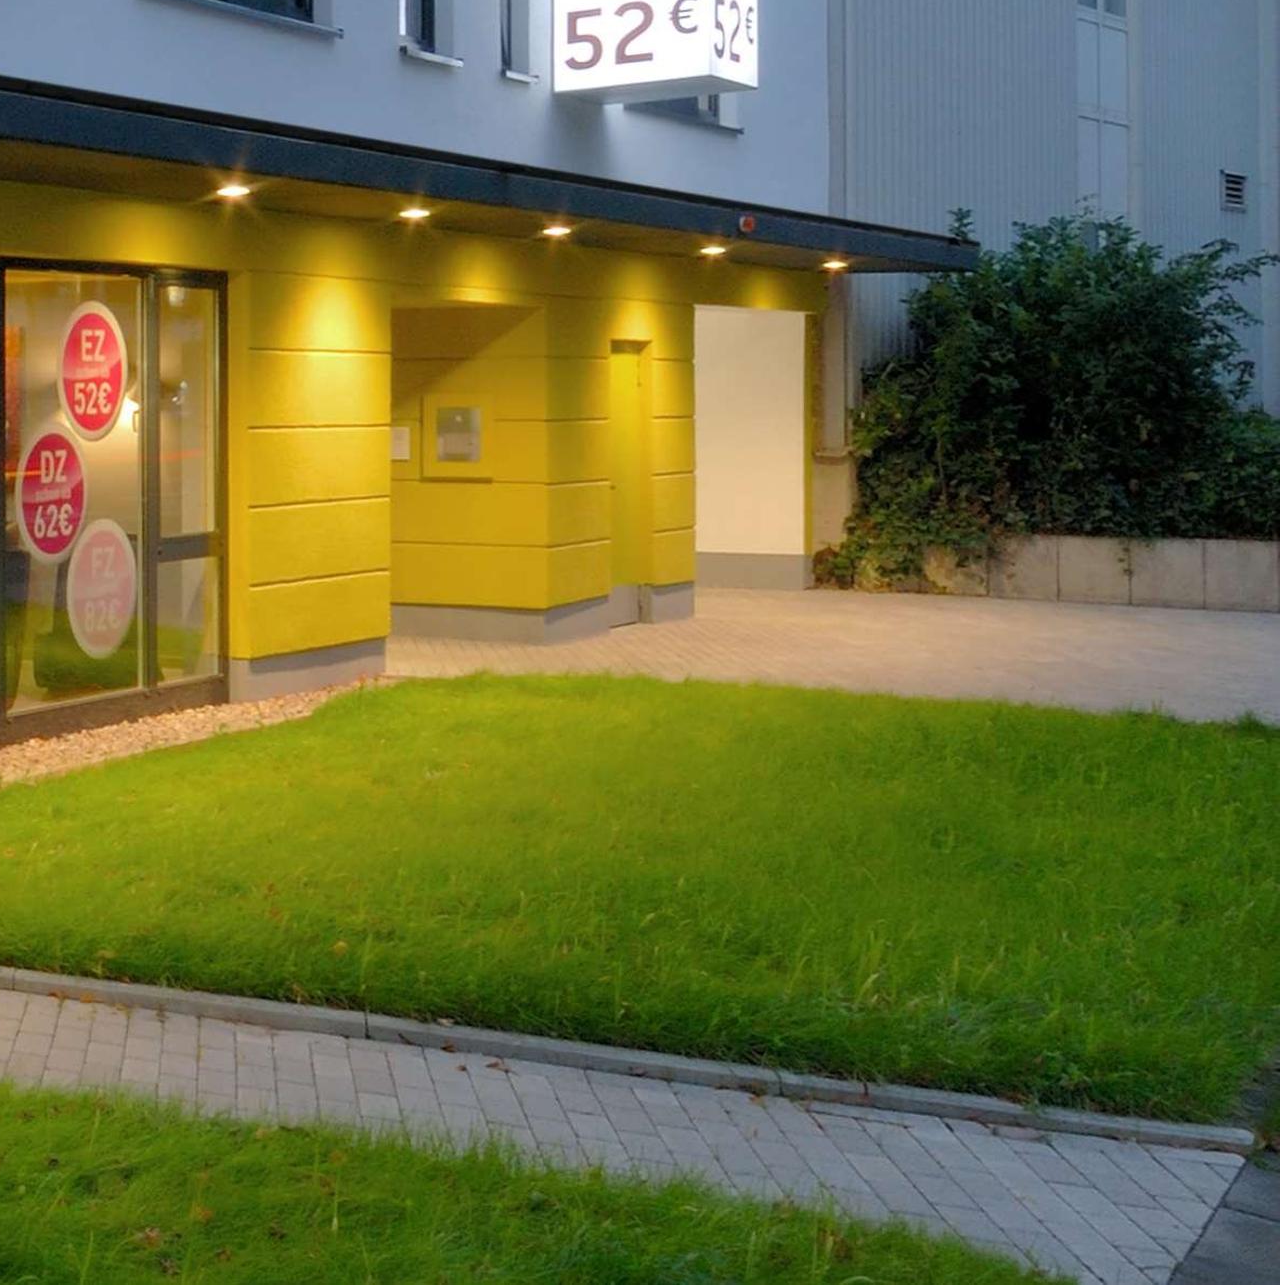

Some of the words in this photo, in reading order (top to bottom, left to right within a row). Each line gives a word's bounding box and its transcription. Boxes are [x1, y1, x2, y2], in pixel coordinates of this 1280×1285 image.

[81, 328, 107, 363] EZ
[73, 381, 113, 416] 52€
[40, 449, 68, 484] DZ
[33, 503, 74, 540] 62€
